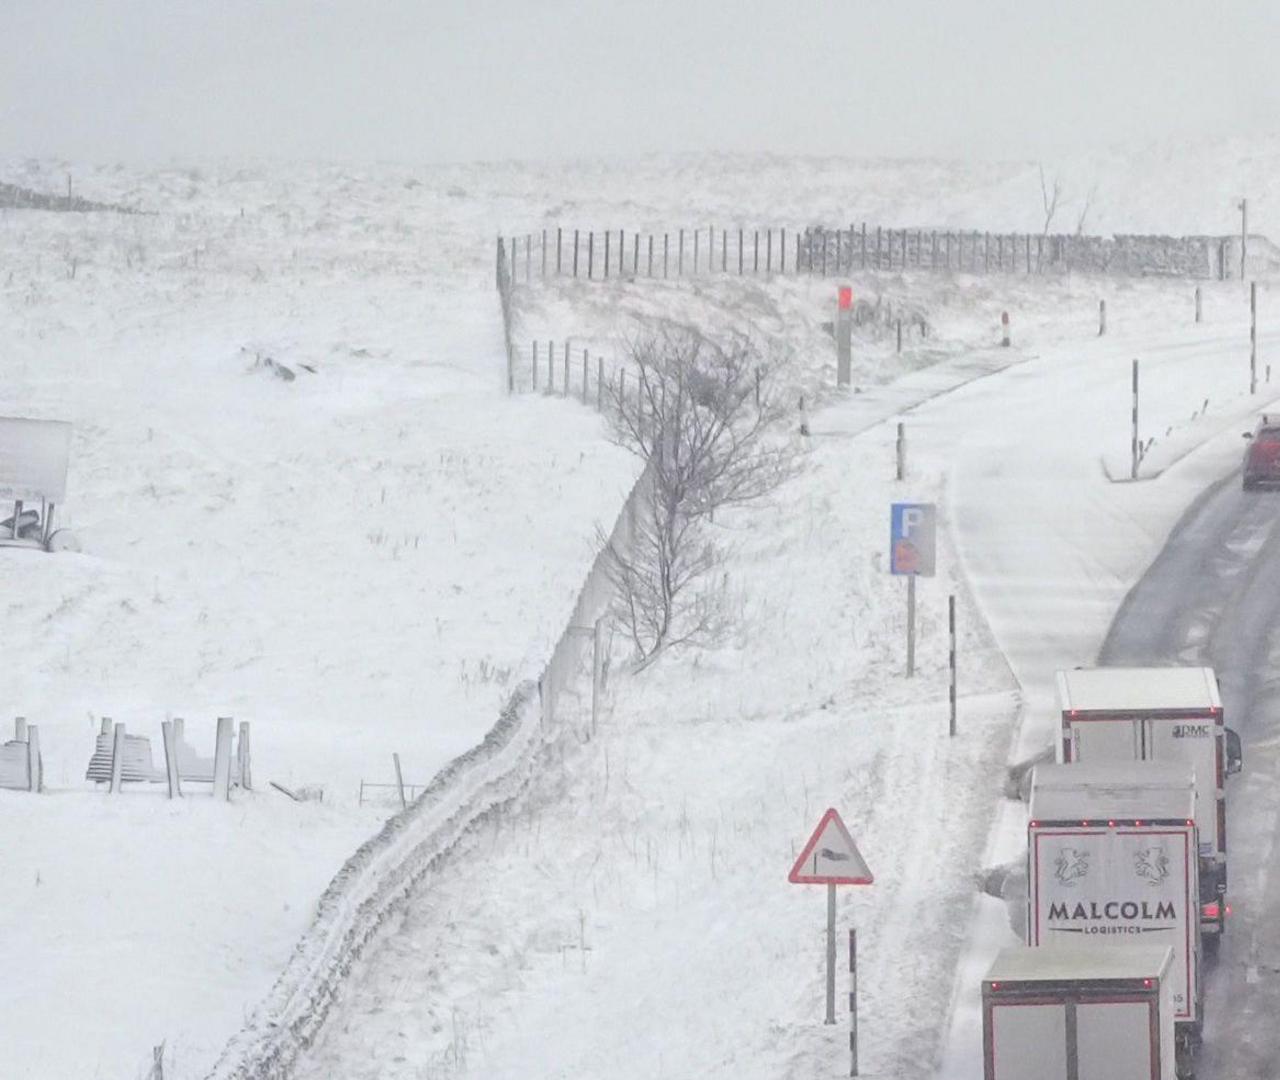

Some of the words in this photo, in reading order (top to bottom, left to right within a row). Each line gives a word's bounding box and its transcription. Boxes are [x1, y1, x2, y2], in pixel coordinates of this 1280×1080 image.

[902, 508, 924, 538] P
[1048, 901, 1177, 920] MALCOLM
[1084, 926, 1142, 935] LOGISTICS
